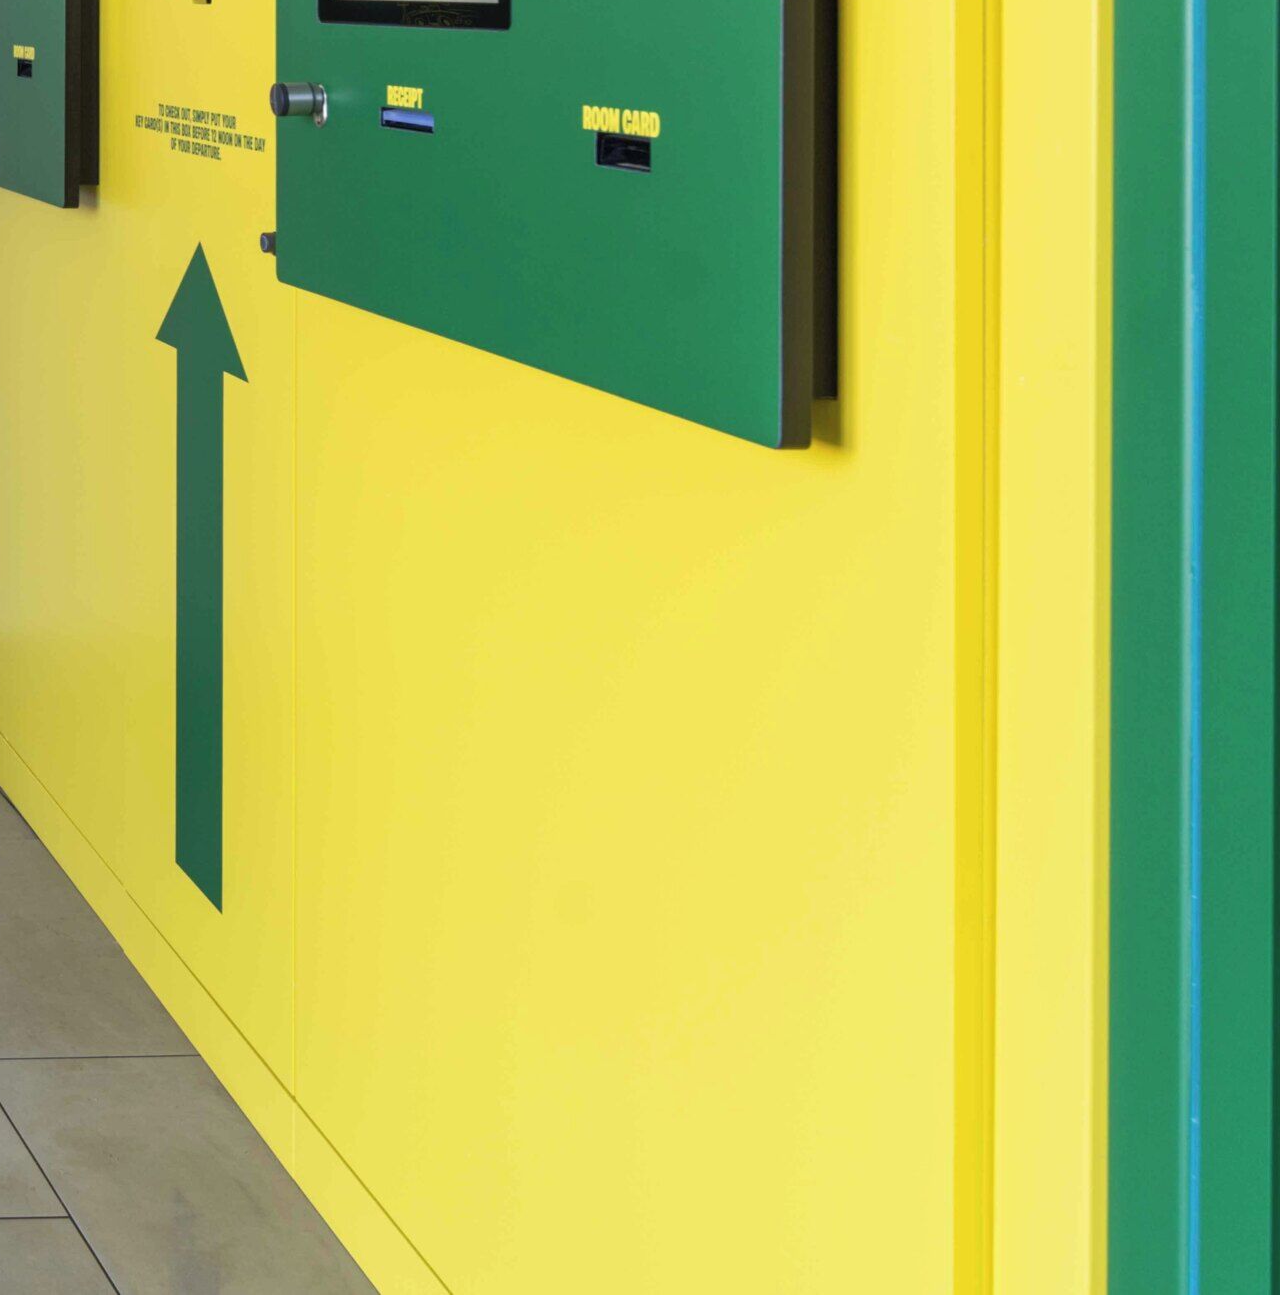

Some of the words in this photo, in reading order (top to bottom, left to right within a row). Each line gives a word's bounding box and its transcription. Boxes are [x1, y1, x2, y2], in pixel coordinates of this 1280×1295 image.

[386, 85, 423, 109] RECEIPT
[165, 105, 180, 120] CHECK
[192, 109, 210, 125] SIMPLY
[210, 112, 221, 126] PUT
[222, 113, 236, 129] YOUR
[582, 104, 619, 134] ROOM
[621, 109, 661, 138] CARD
[170, 121, 181, 135] THIS
[181, 123, 191, 137] BOX
[192, 125, 210, 142] BEFORE
[234, 132, 242, 148] ON
[243, 134, 253, 150] THE
[254, 136, 266, 152] DAY
[171, 137, 177, 150] OF
[178, 138, 190, 153] YOUR
